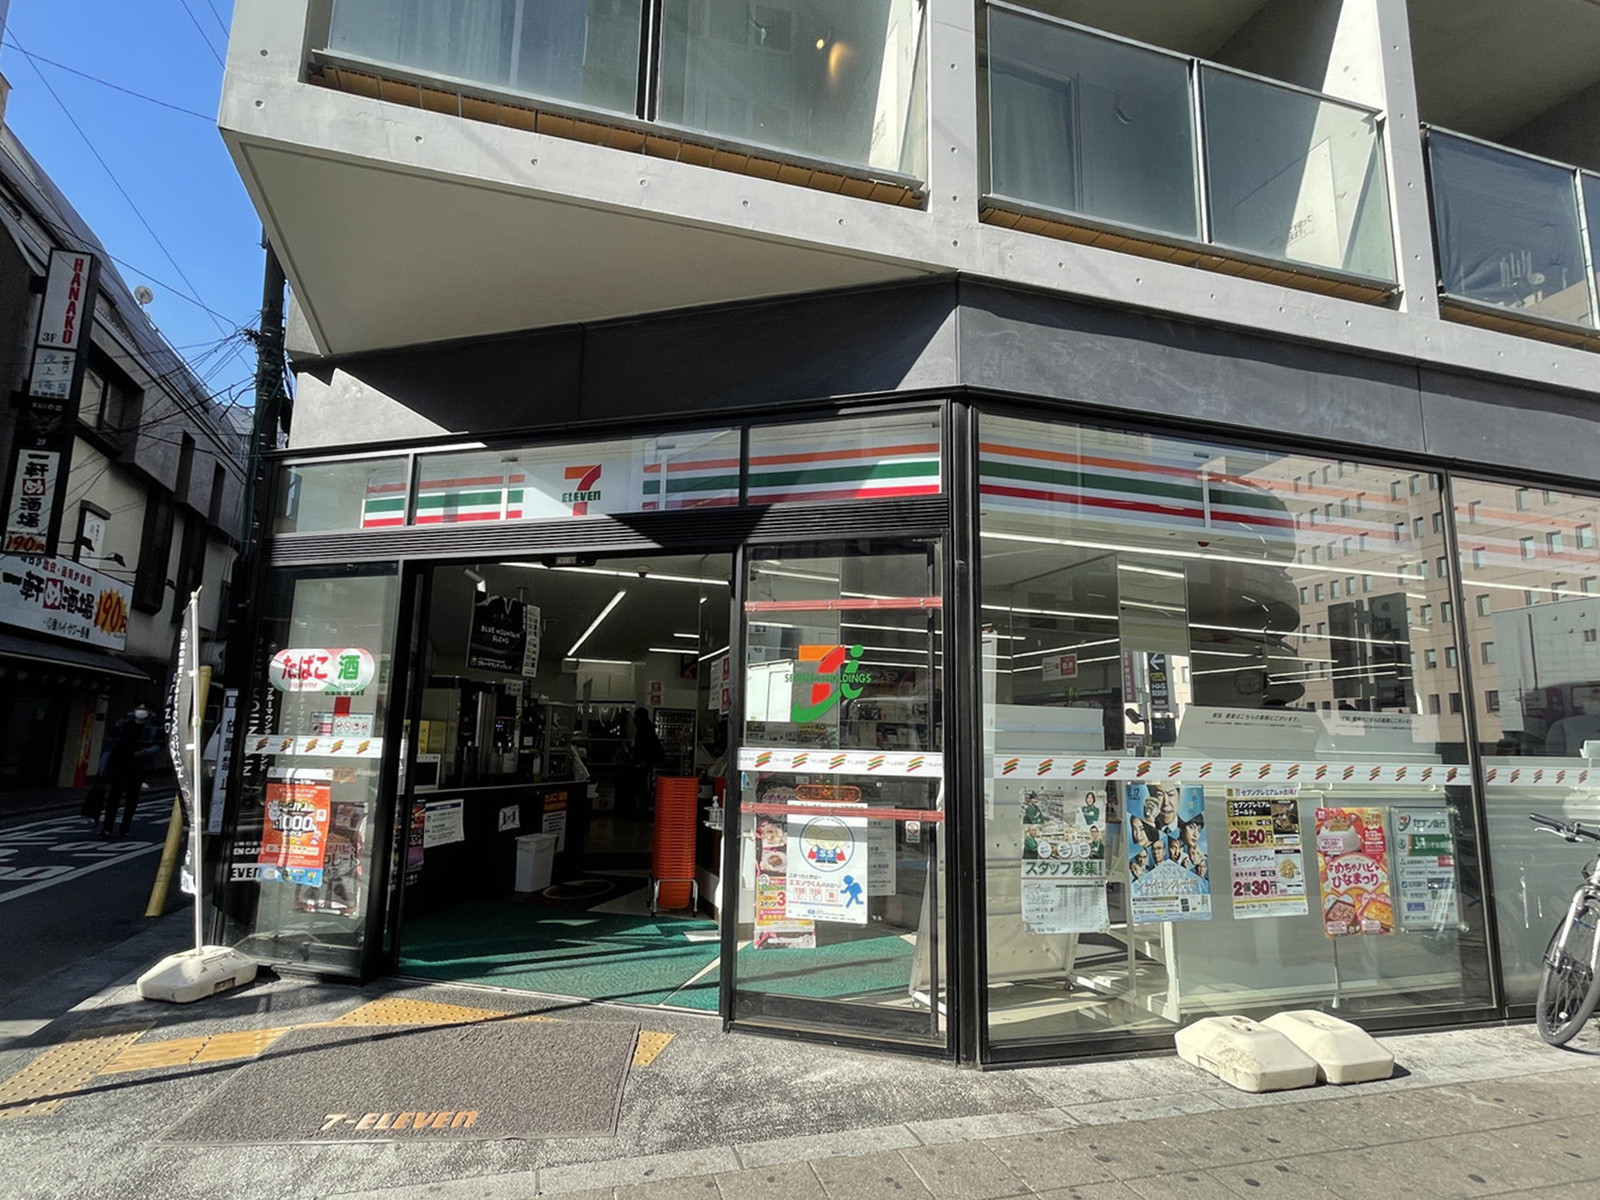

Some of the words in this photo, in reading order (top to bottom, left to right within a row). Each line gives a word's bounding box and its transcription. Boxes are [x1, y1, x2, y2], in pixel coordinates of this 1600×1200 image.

[62, 258, 84, 344] HANAKO
[42, 332, 57, 342] 3F
[282, 655, 328, 680] たばこ
[338, 655, 361, 680] 酒
[826, 673, 872, 683] HOLDINGS
[1025, 860, 1102, 877] スタッフ募集!
[1332, 873, 1379, 888] ひなまつり
